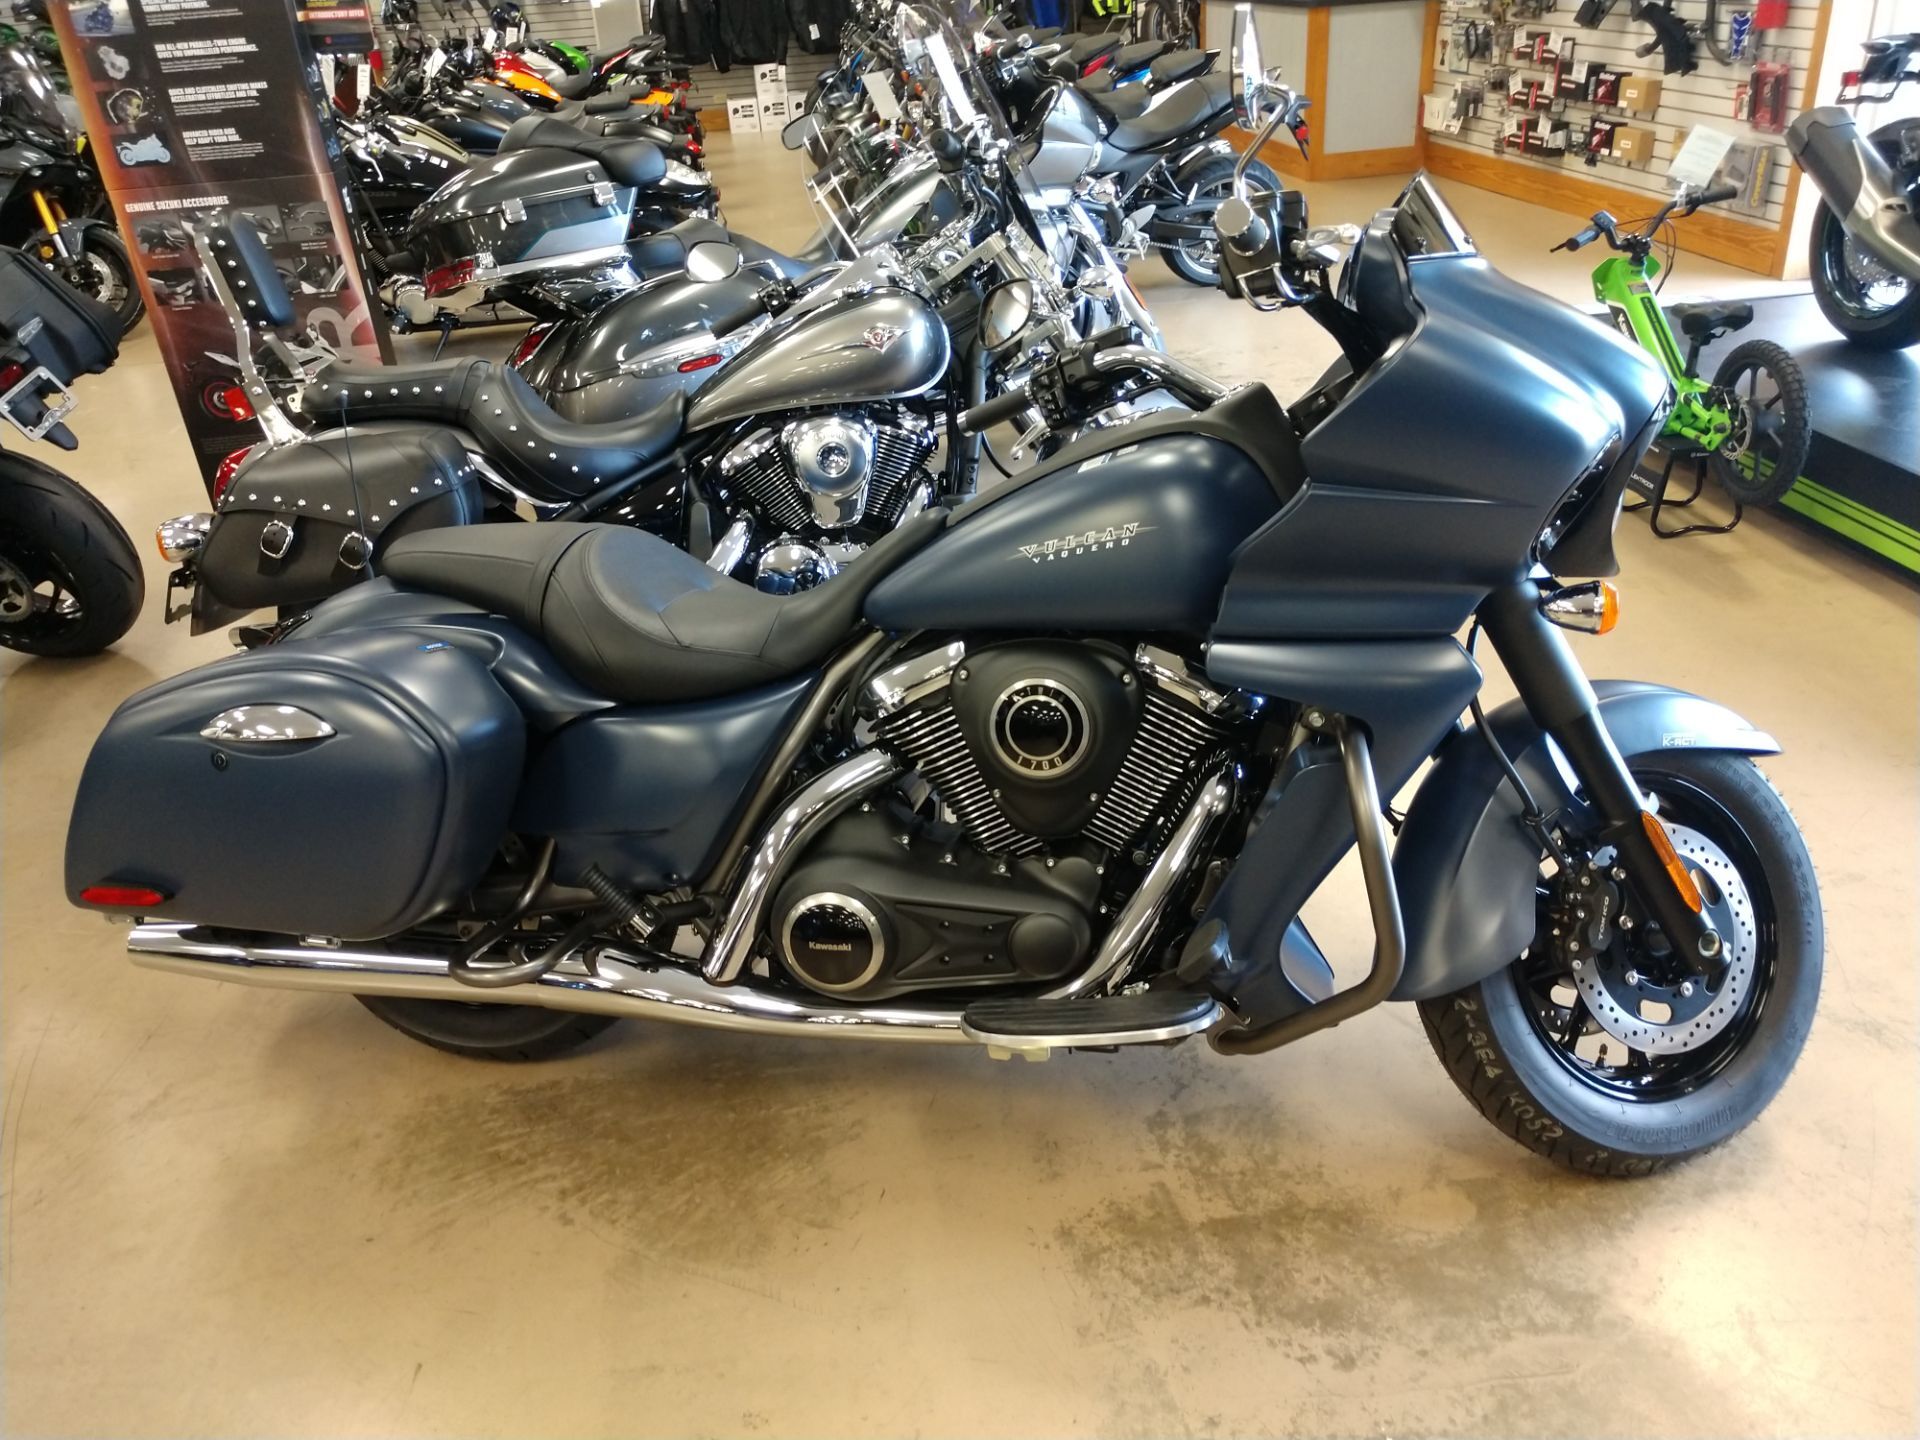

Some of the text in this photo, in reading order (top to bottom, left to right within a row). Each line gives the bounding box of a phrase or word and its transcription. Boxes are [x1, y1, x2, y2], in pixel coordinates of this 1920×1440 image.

[124, 195, 230, 213] GENUINE SUZUKI ACCESSORIES
[1018, 522, 1140, 558] VULCAN
[1032, 539, 1130, 564] VAQUERO
[1017, 755, 1063, 771] 1700
[1598, 895, 1610, 941] TOKICO
[808, 941, 852, 952] Kawasaki
